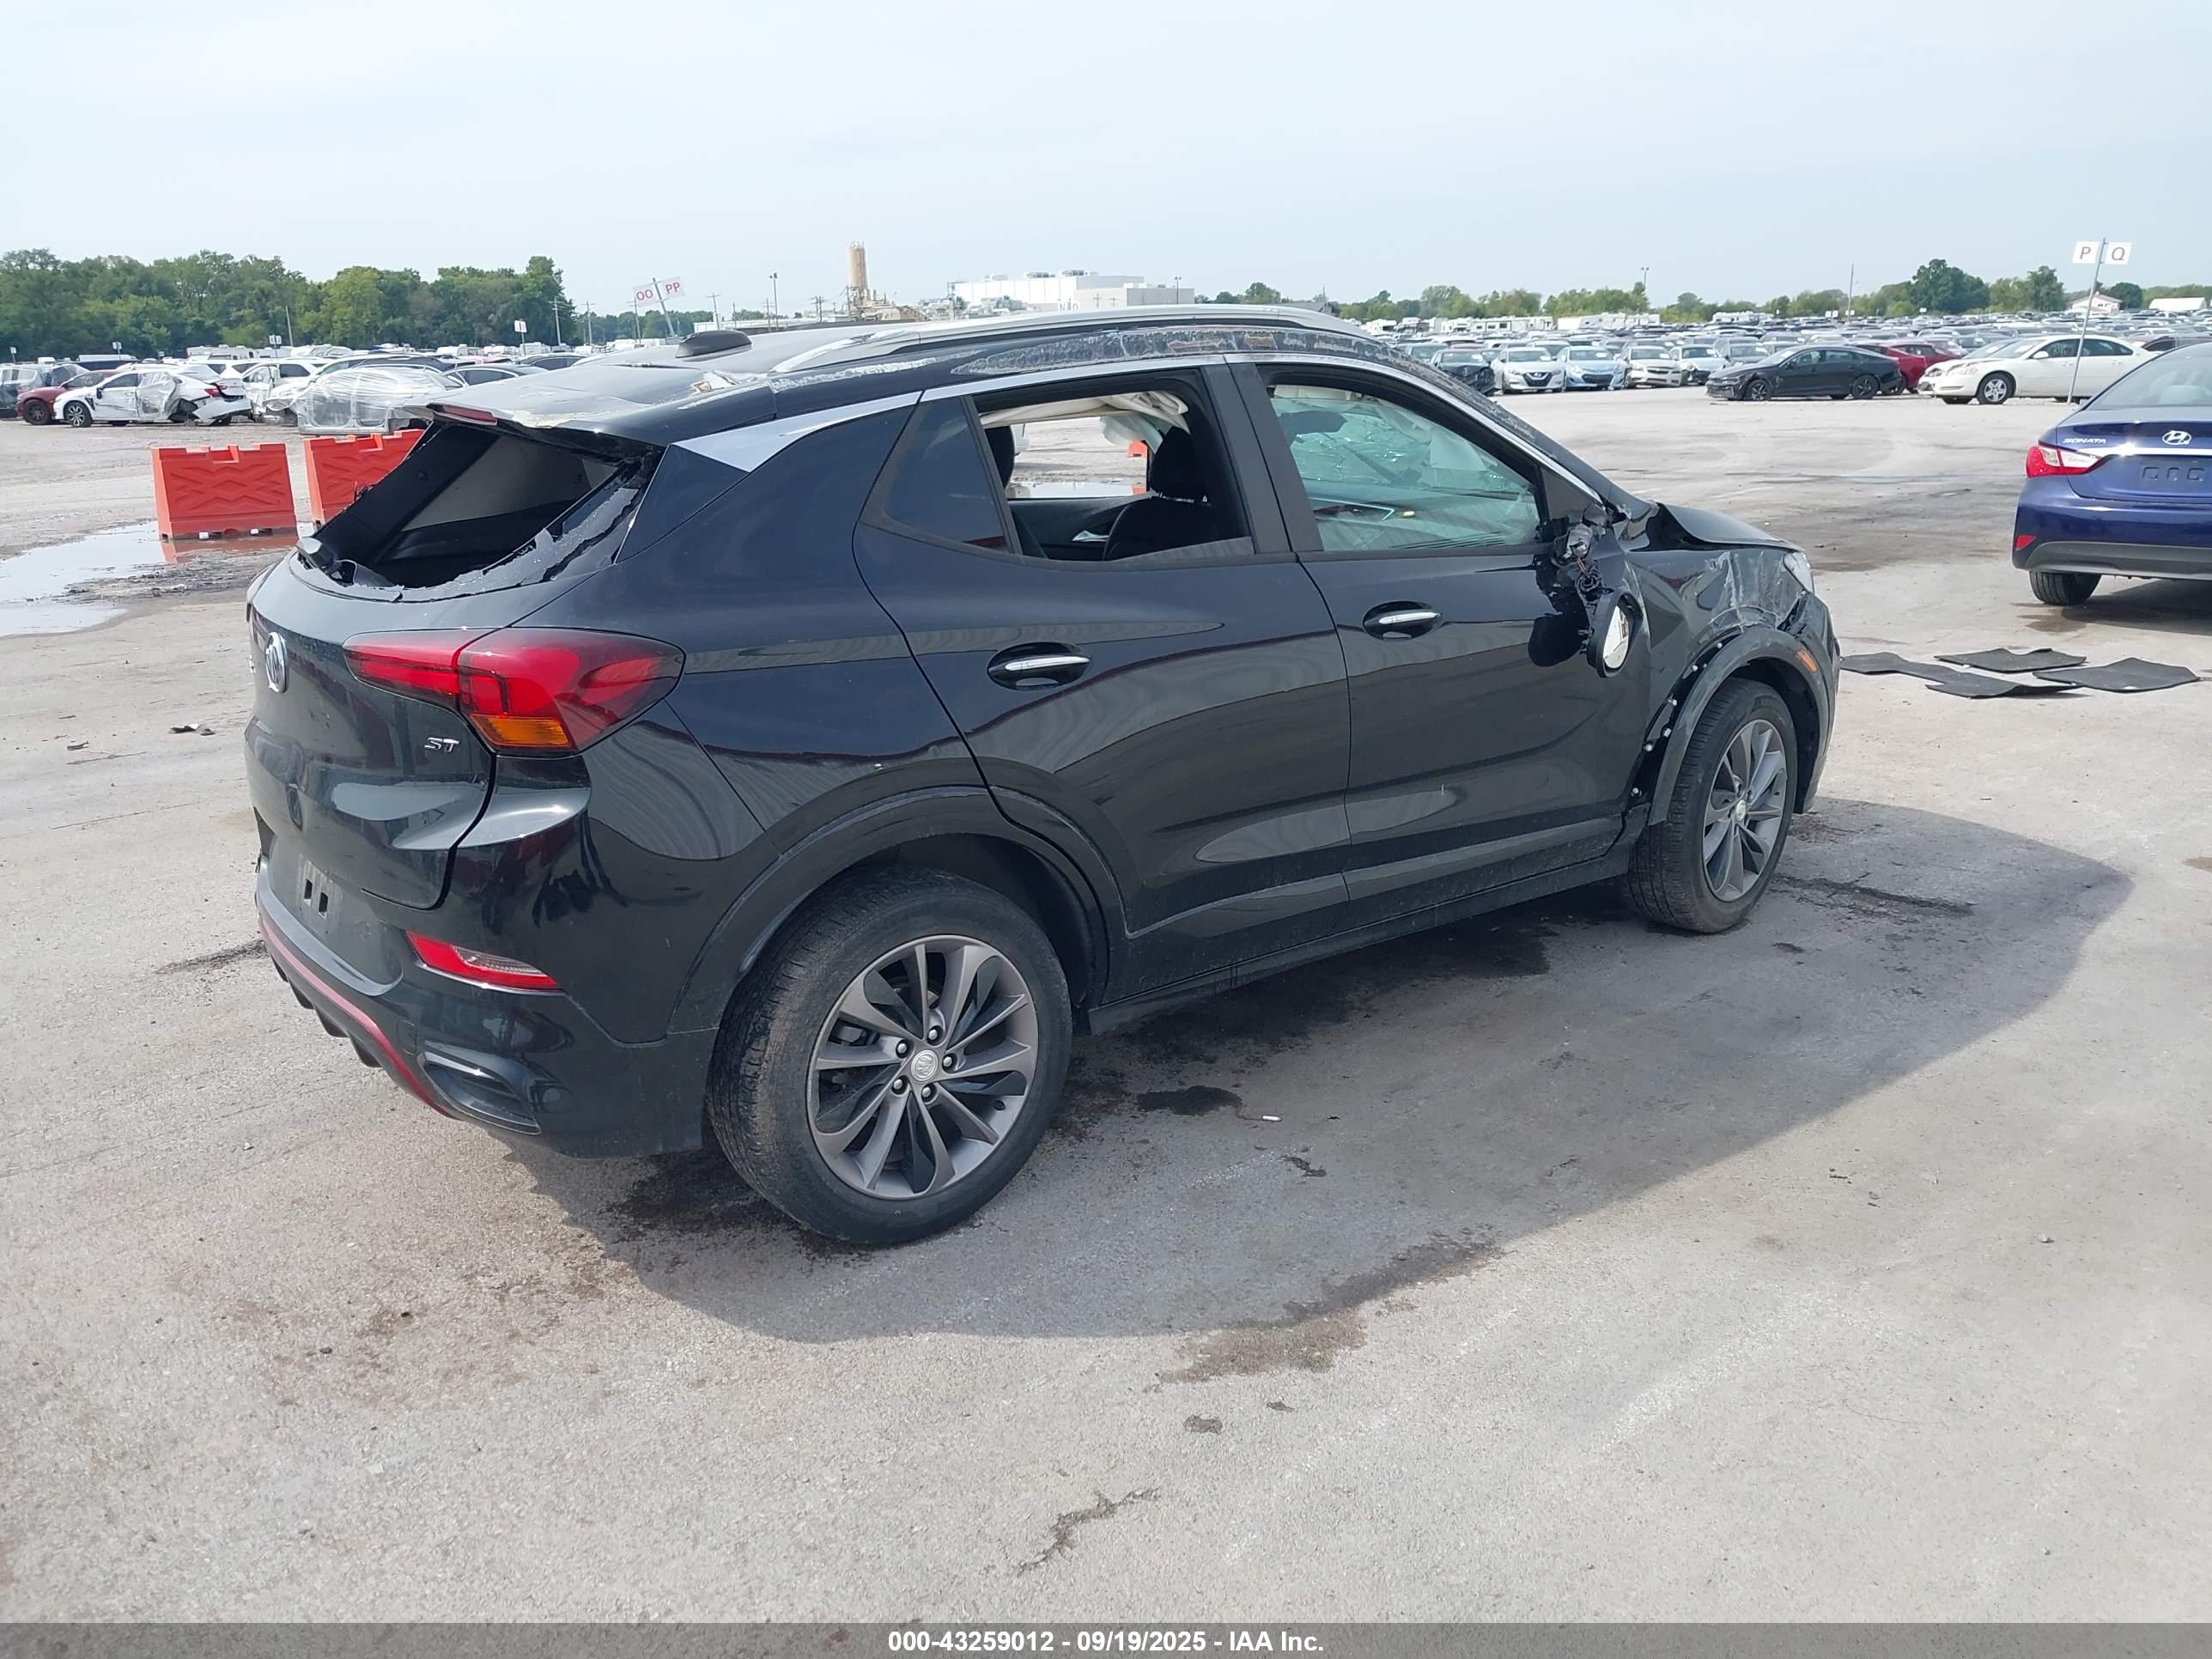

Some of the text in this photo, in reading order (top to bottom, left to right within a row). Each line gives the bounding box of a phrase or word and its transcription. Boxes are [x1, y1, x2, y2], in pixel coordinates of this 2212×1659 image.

[2079, 246, 2092, 259] P
[2111, 246, 2126, 261] Q
[665, 282, 680, 294] PP
[635, 289, 653, 301] OO
[424, 737, 460, 753] ST
